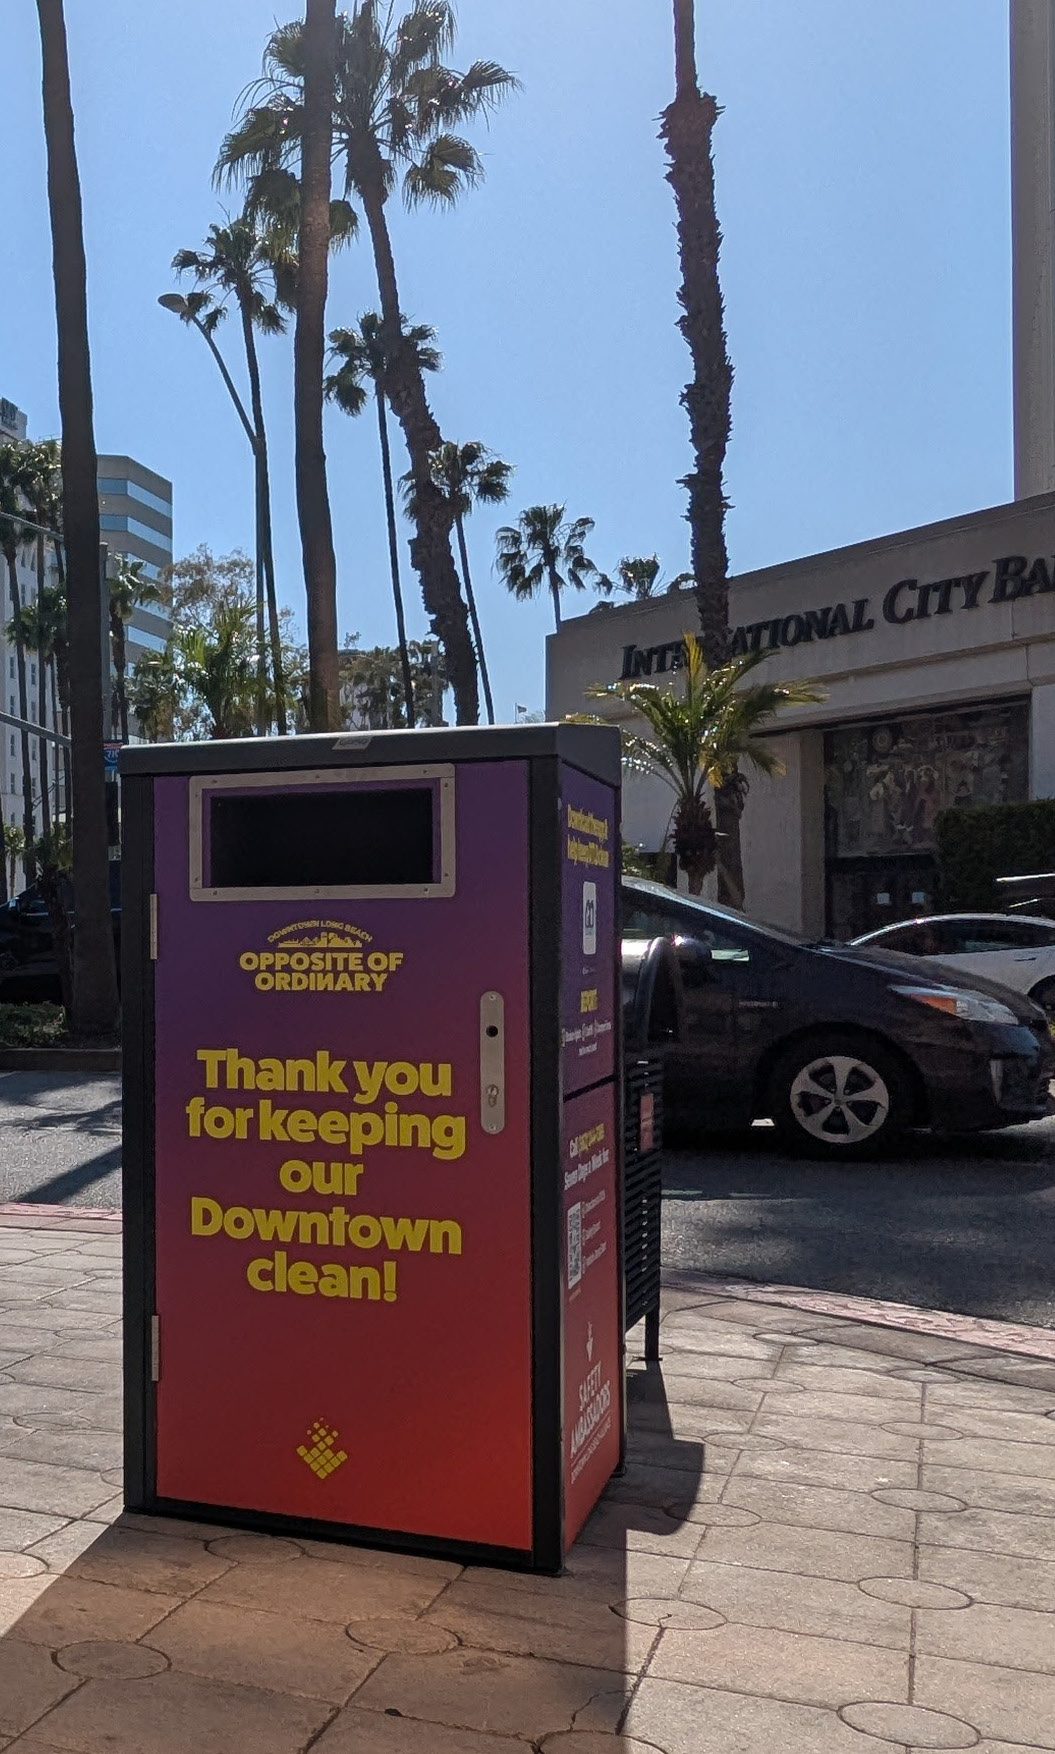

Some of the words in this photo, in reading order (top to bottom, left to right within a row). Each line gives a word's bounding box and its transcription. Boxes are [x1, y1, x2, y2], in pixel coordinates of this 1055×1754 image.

[620, 599, 875, 680] INTEATIONAL
[883, 570, 991, 624] CITY
[987, 555, 1055, 604] BA
[267, 920, 320, 943] DOWNTOWN
[320, 920, 344, 930] LONG
[344, 923, 373, 943] BEACH
[239, 952, 364, 971] OPPOSITE
[367, 952, 404, 971] OF
[254, 972, 388, 991] ORDINARY
[197, 1048, 349, 1093] Thank
[353, 1060, 452, 1105] you
[186, 1097, 254, 1139] for
[259, 1099, 466, 1160] keeping
[279, 1159, 364, 1196] our
[191, 1197, 462, 1255] Downtown
[247, 1251, 397, 1302] clean!
[579, 1360, 601, 1412] SAFETY
